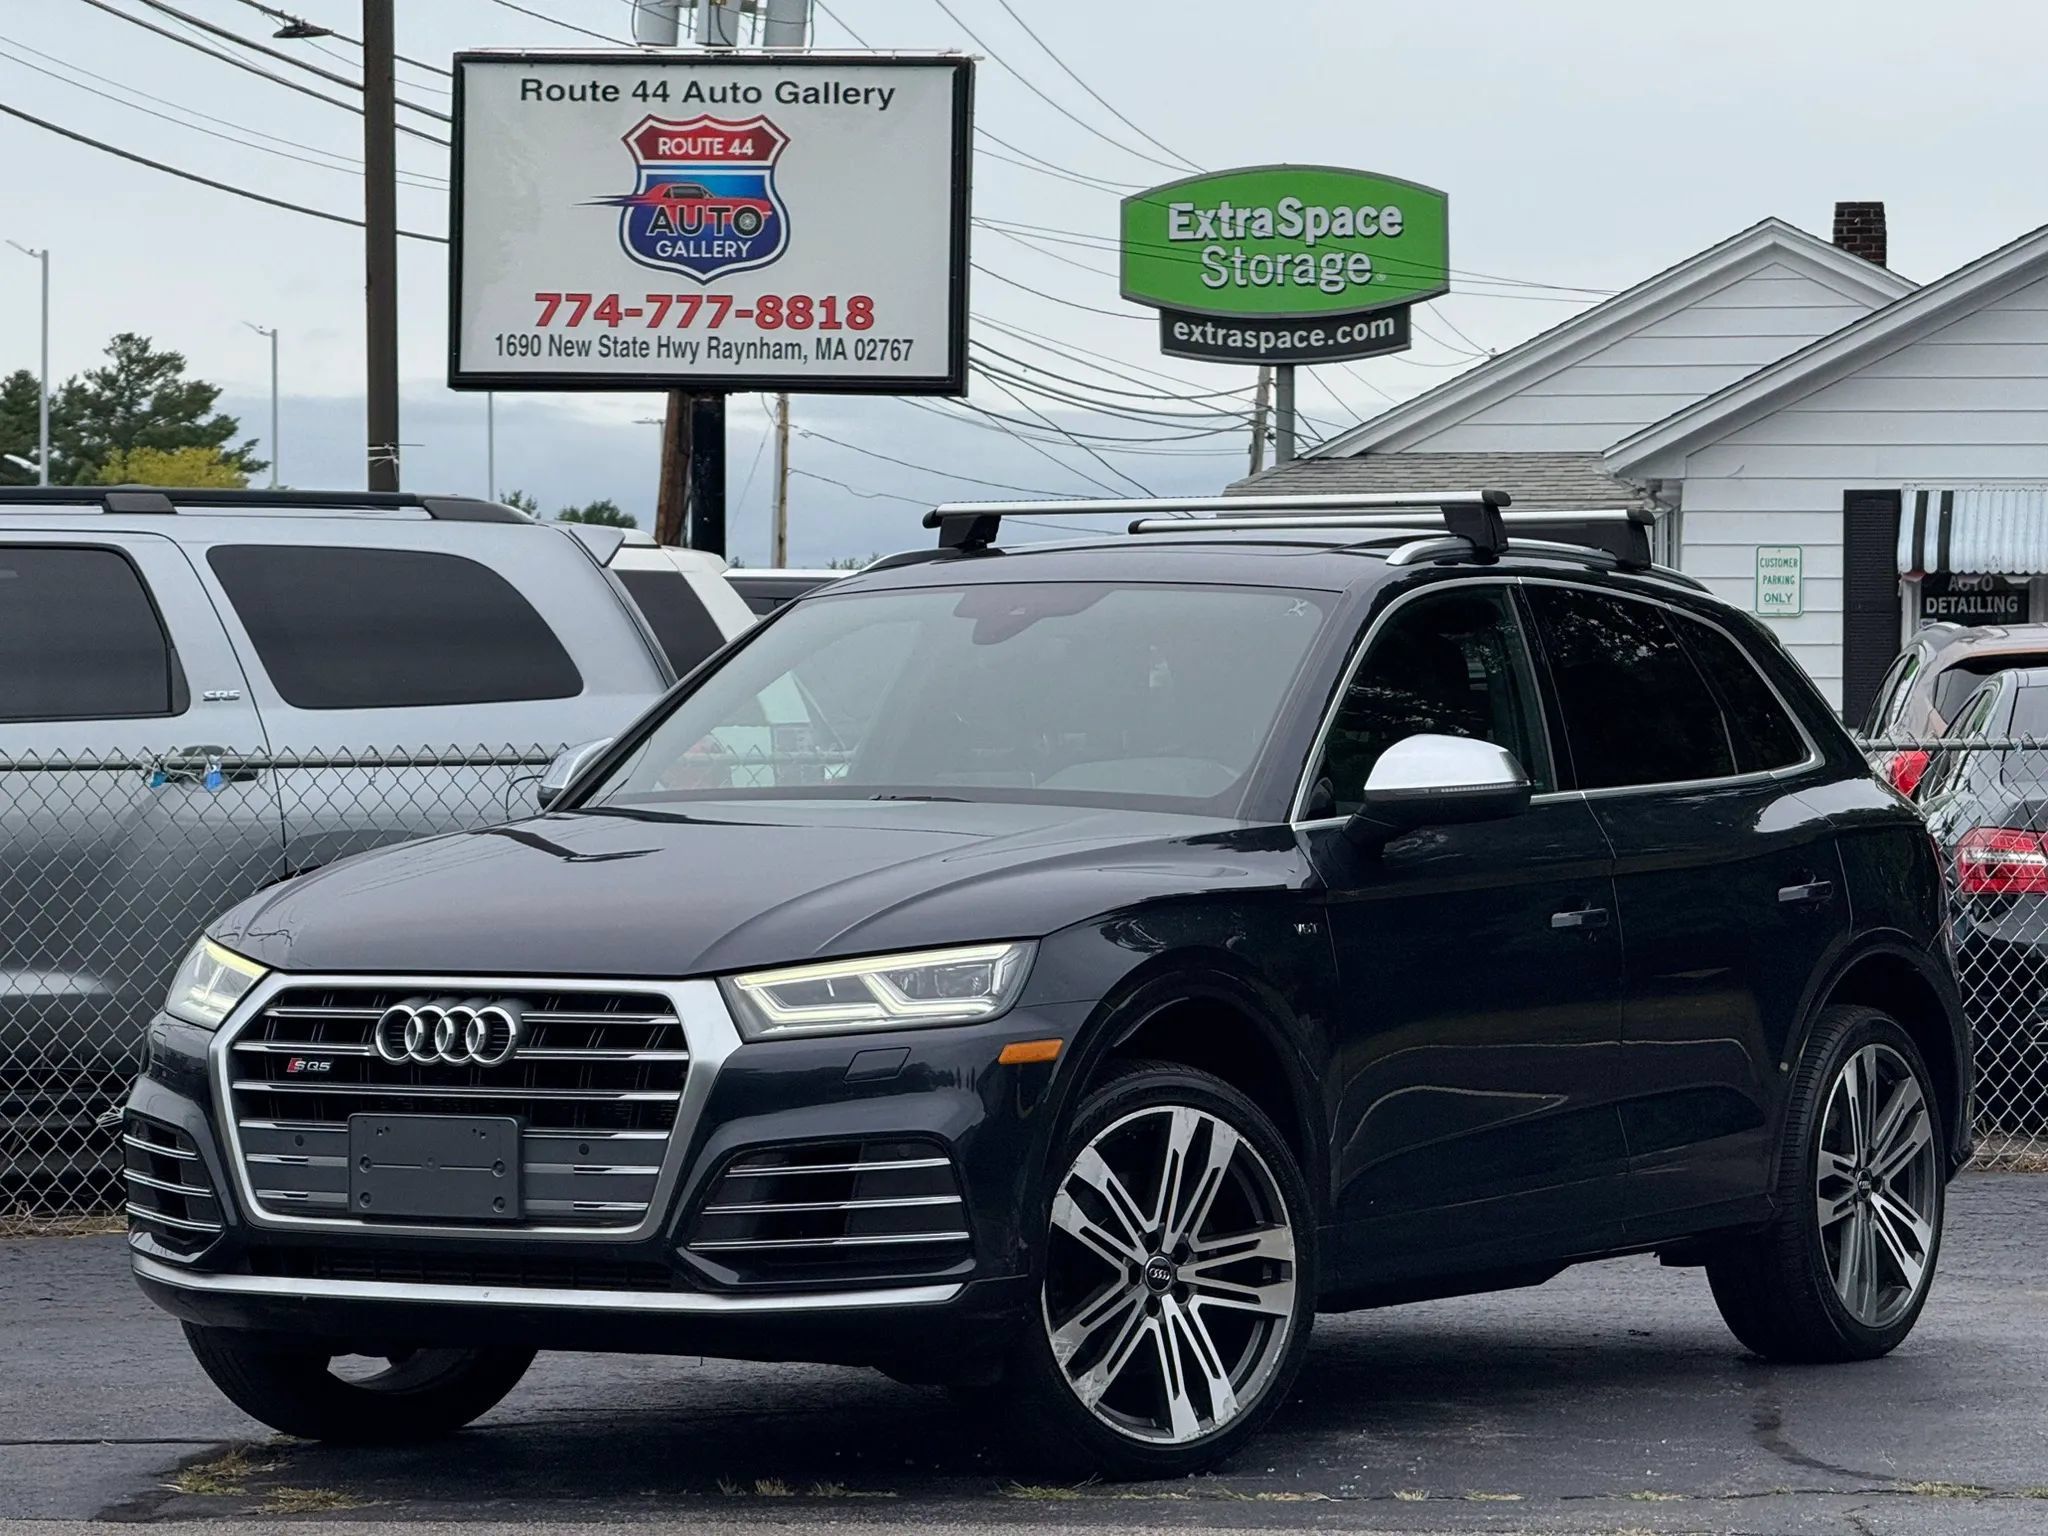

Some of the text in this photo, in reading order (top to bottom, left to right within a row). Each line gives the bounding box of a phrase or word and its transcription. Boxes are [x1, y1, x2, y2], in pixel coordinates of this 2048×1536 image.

[521, 78, 896, 111] Route 44 Auto Gallery
[658, 137, 754, 156] ROUTE 44
[646, 204, 765, 238] AUTO
[1168, 197, 1404, 246] ExtraSpace
[655, 240, 752, 258] GALLERY
[1200, 245, 1372, 293] Storage
[535, 292, 875, 330] 774-777-8818
[1173, 316, 1395, 353] extraspace.com
[495, 334, 914, 366] 1690 New State Hwy Raynham, MA 02767
[1760, 557, 1798, 568] CUSTOMER
[1762, 575, 1795, 585] PARKING
[1764, 592, 1793, 603] ONLY
[1926, 596, 2018, 613] DETAILING
[293, 1059, 331, 1072] SQ5
